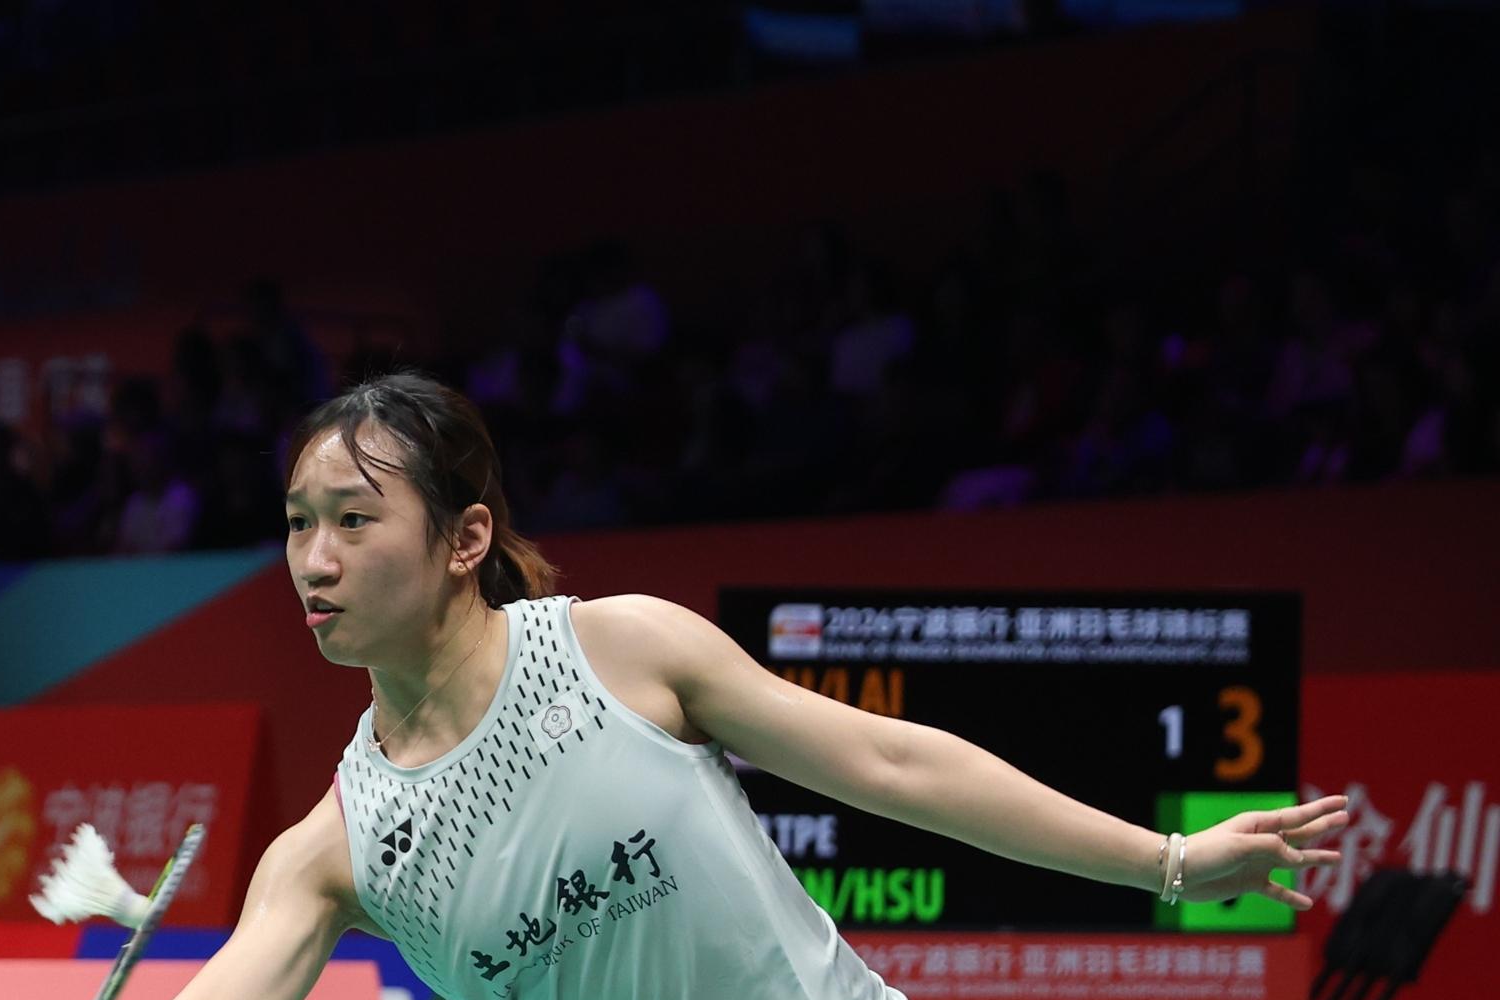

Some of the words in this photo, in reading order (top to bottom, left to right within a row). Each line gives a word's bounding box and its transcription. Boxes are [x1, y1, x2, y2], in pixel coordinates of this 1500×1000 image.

[1158, 704, 1185, 759] 1
[1214, 684, 1264, 782] 3
[471, 829, 660, 981] 土地銀行
[577, 917, 601, 939] OF
[605, 875, 679, 922] TAIWAN
[794, 866, 946, 922] N/HSU
